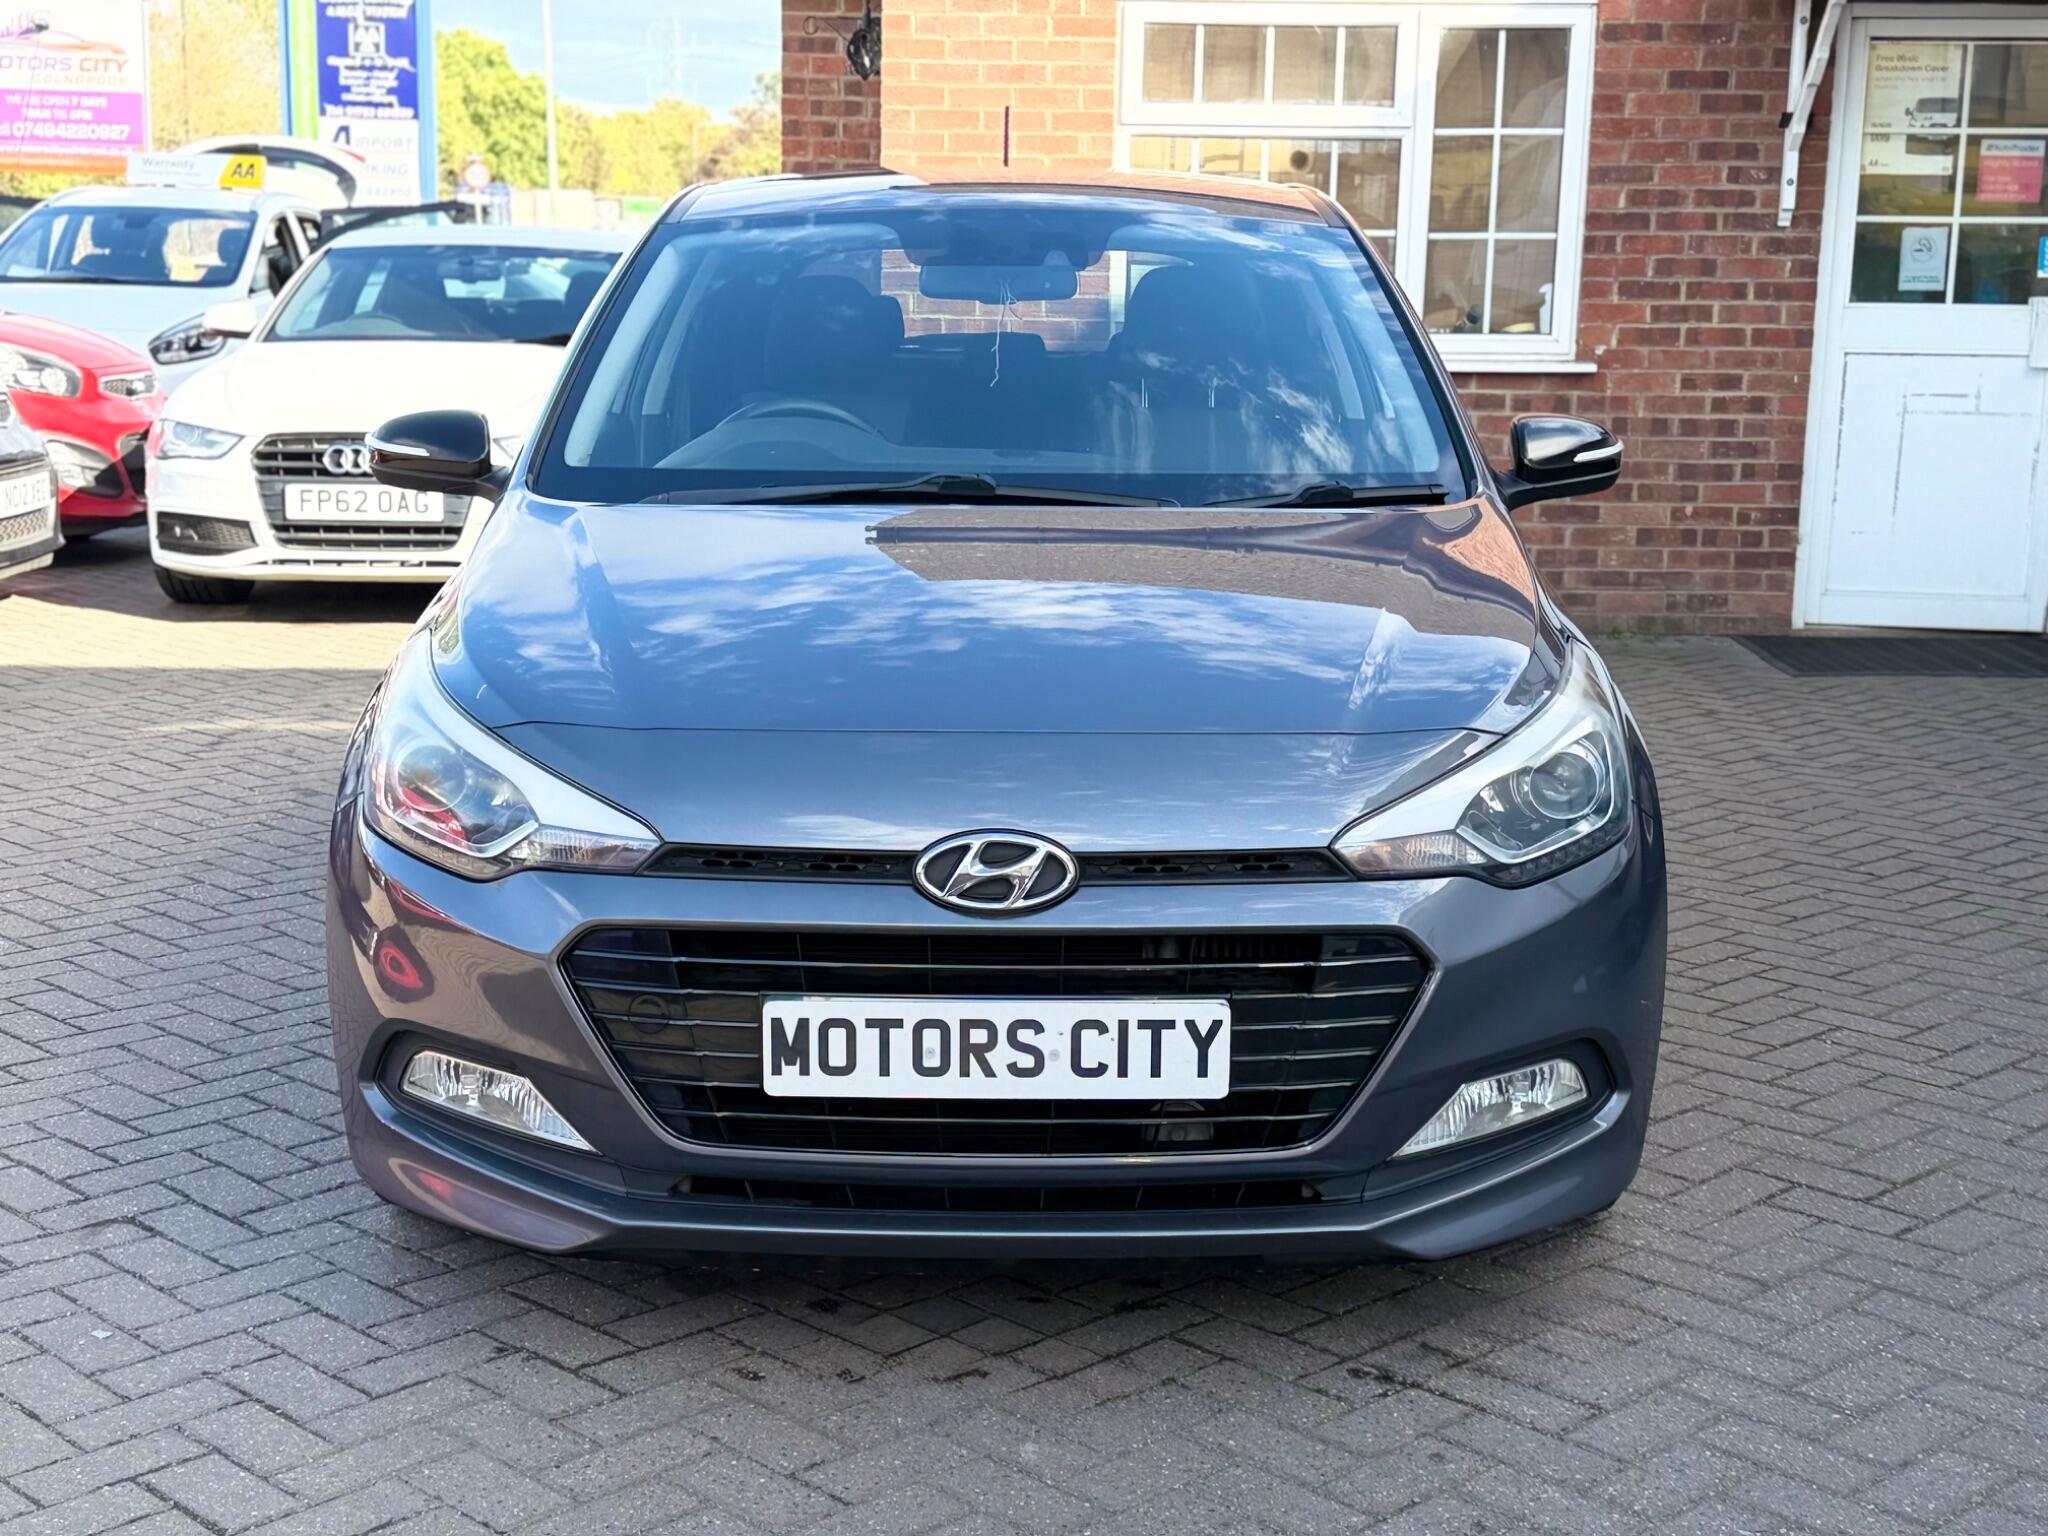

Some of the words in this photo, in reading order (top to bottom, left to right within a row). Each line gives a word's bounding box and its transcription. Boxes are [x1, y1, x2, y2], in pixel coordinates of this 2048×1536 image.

[0, 55, 72, 71] OTORS
[79, 57, 128, 73] CITY
[1924, 64, 1950, 73] Cover
[43, 95, 69, 107] OPEN
[142, 158, 195, 170] Warranty
[231, 162, 255, 179] AA
[359, 163, 407, 176] RKING
[300, 489, 368, 513] FP62
[378, 490, 429, 513] OAG
[771, 1017, 1045, 1078] MOTORS
[1070, 1019, 1223, 1078] CITY
